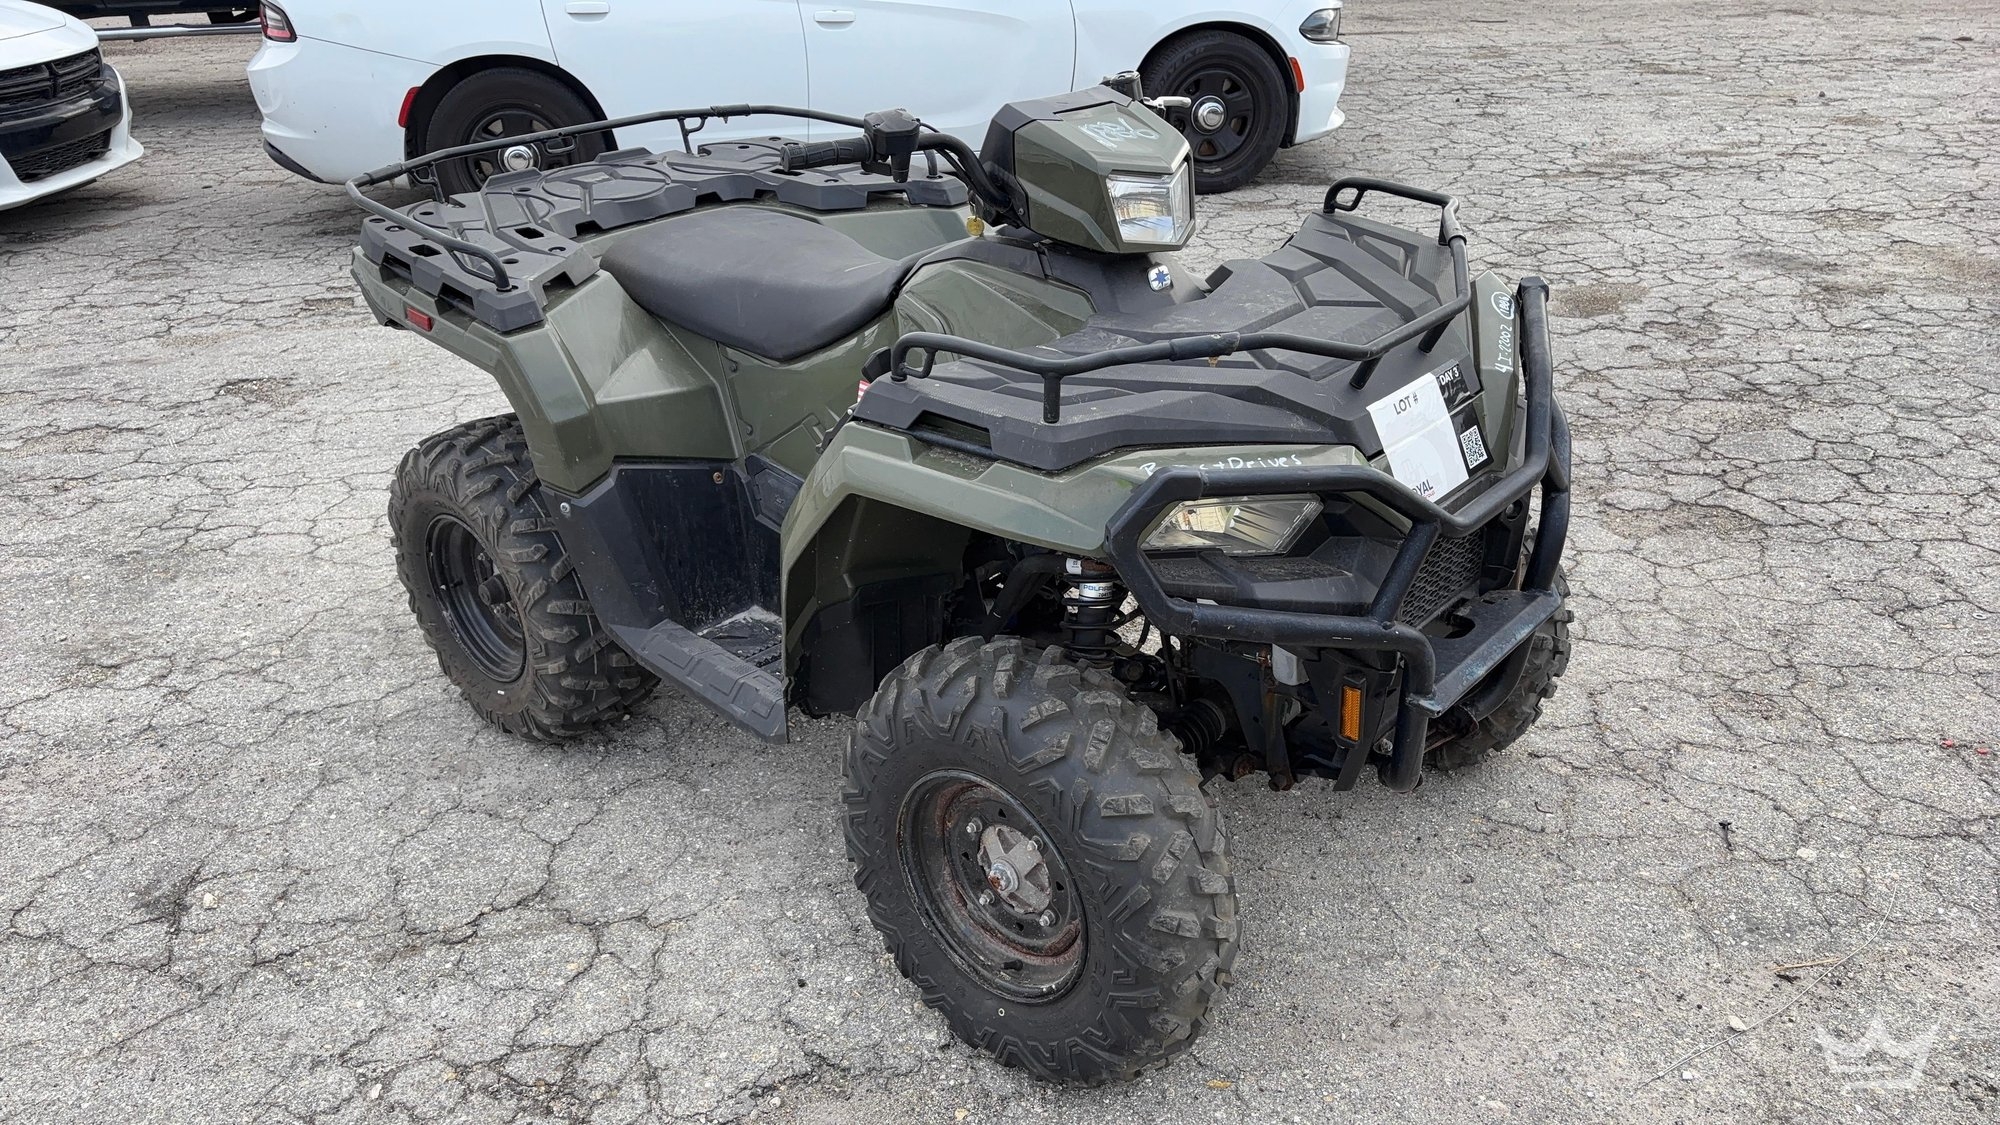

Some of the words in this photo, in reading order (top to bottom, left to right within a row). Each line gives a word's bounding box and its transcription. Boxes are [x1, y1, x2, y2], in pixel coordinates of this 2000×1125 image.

[1439, 369, 1454, 386] DAY
[1452, 366, 1459, 378] 3
[1393, 395, 1412, 415] LOT
[1412, 391, 1419, 405] #
[1411, 479, 1434, 496] YAL
